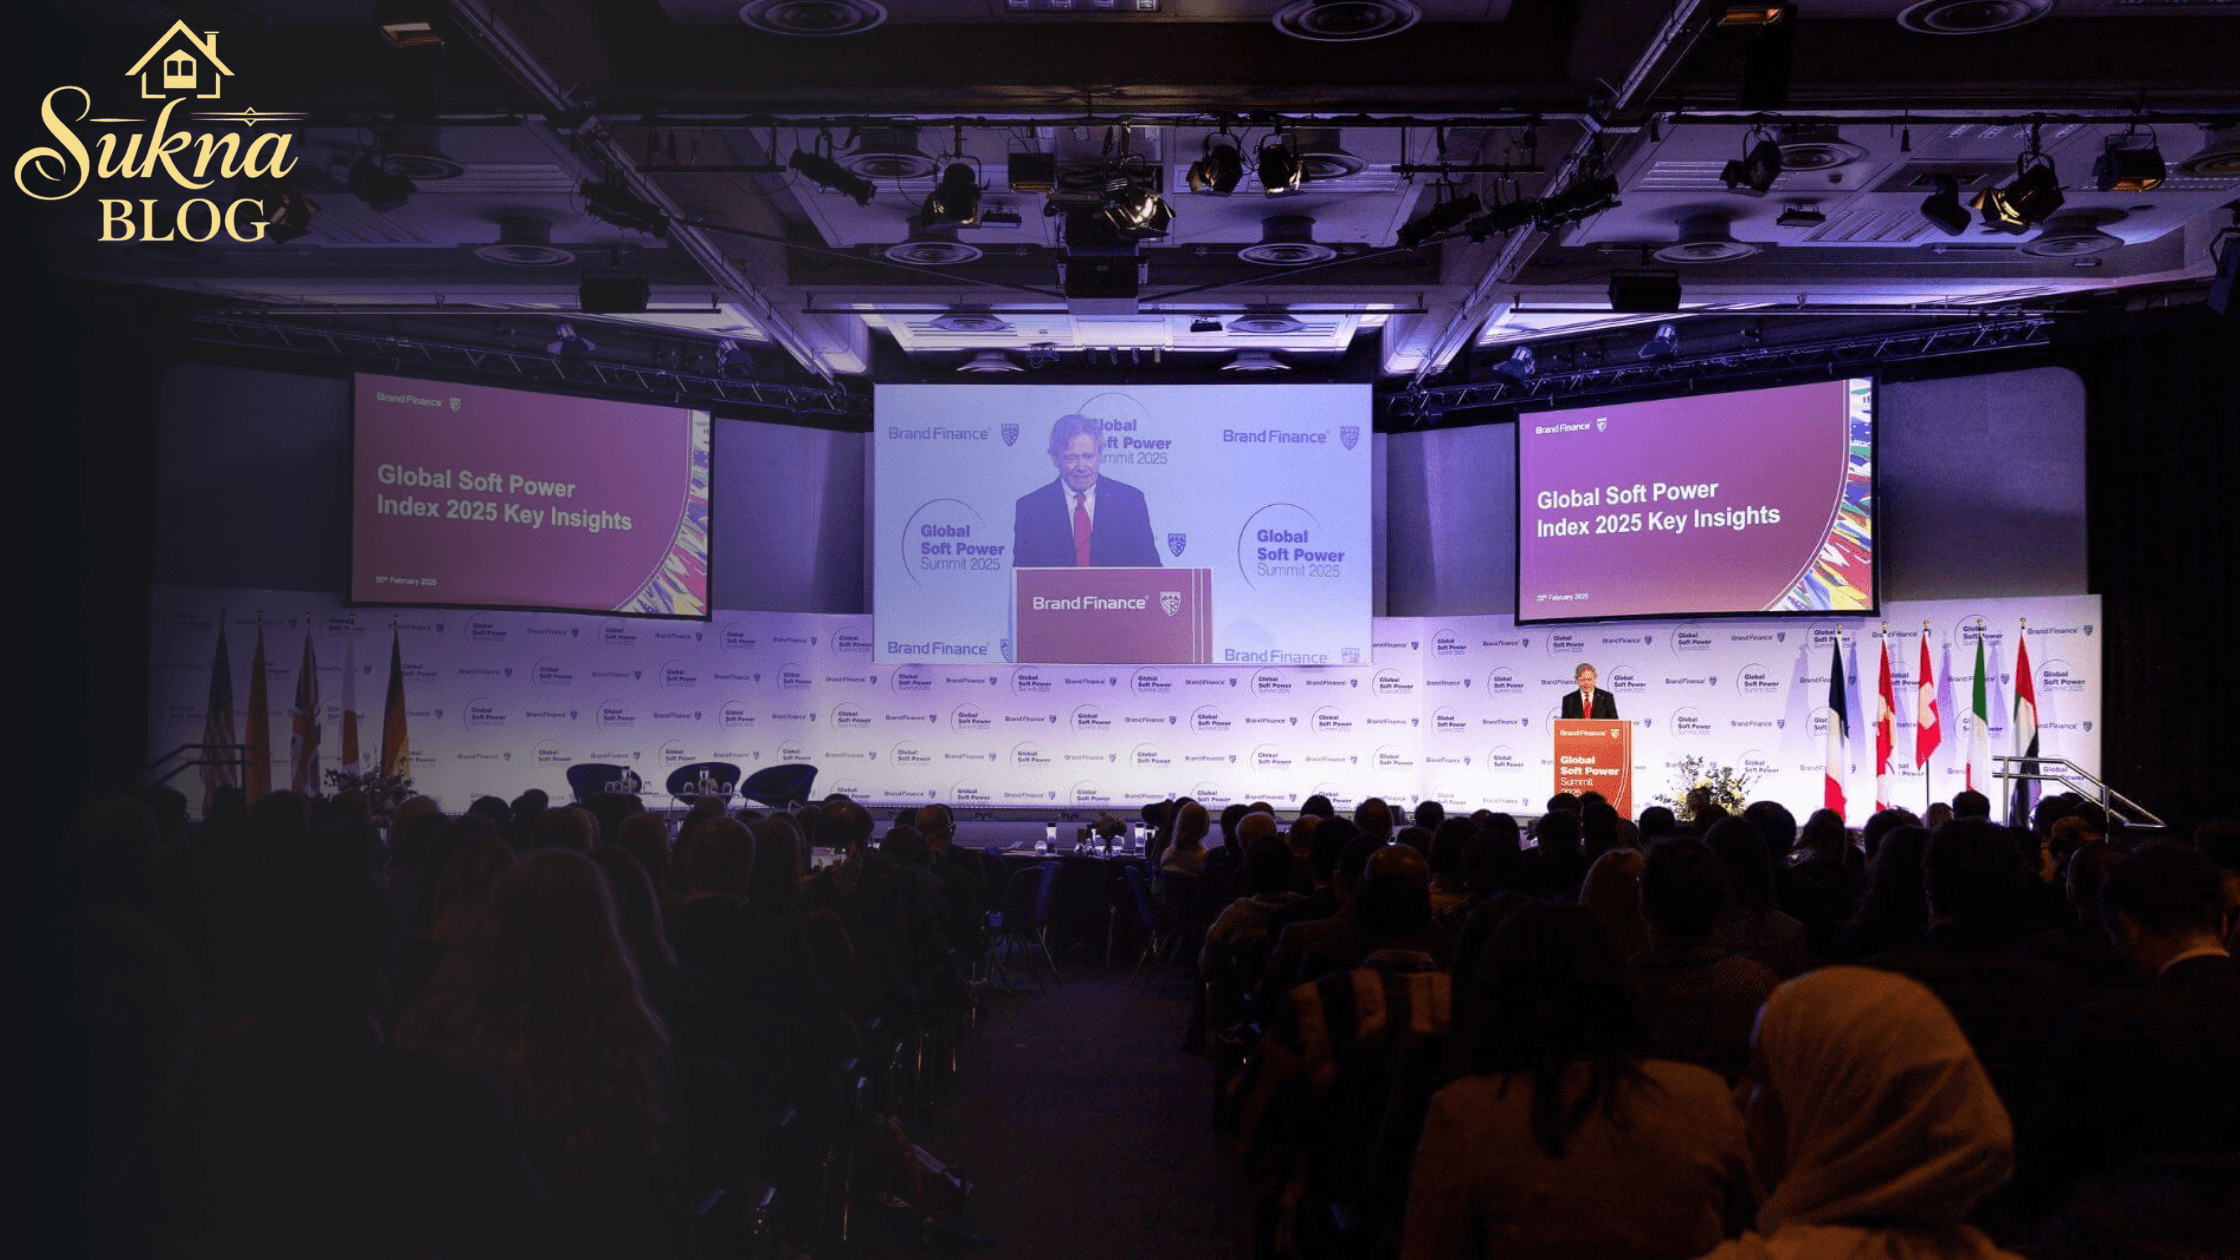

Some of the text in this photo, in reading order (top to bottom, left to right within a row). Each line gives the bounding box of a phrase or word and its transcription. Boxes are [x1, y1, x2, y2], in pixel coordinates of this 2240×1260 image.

[1123, 437, 1172, 449] Power
[1137, 452, 1168, 465] 2025
[377, 464, 576, 498] Global Soft Power
[1537, 481, 1719, 510] Global Soft Power
[377, 494, 633, 533] Index 2025 Key Insights
[1537, 505, 1781, 538] Index 2025 Key Insights
[921, 524, 970, 538] Global
[1257, 530, 1308, 544] Global
[921, 542, 1005, 556] Soft Power
[1257, 548, 1345, 562] Soft Power
[921, 557, 1001, 571] Summit 2025
[1257, 563, 1340, 578] Summit 2025
[1560, 756, 1596, 764] Global
[1560, 767, 1619, 776] Soft Power
[1560, 777, 1594, 786] Summit
